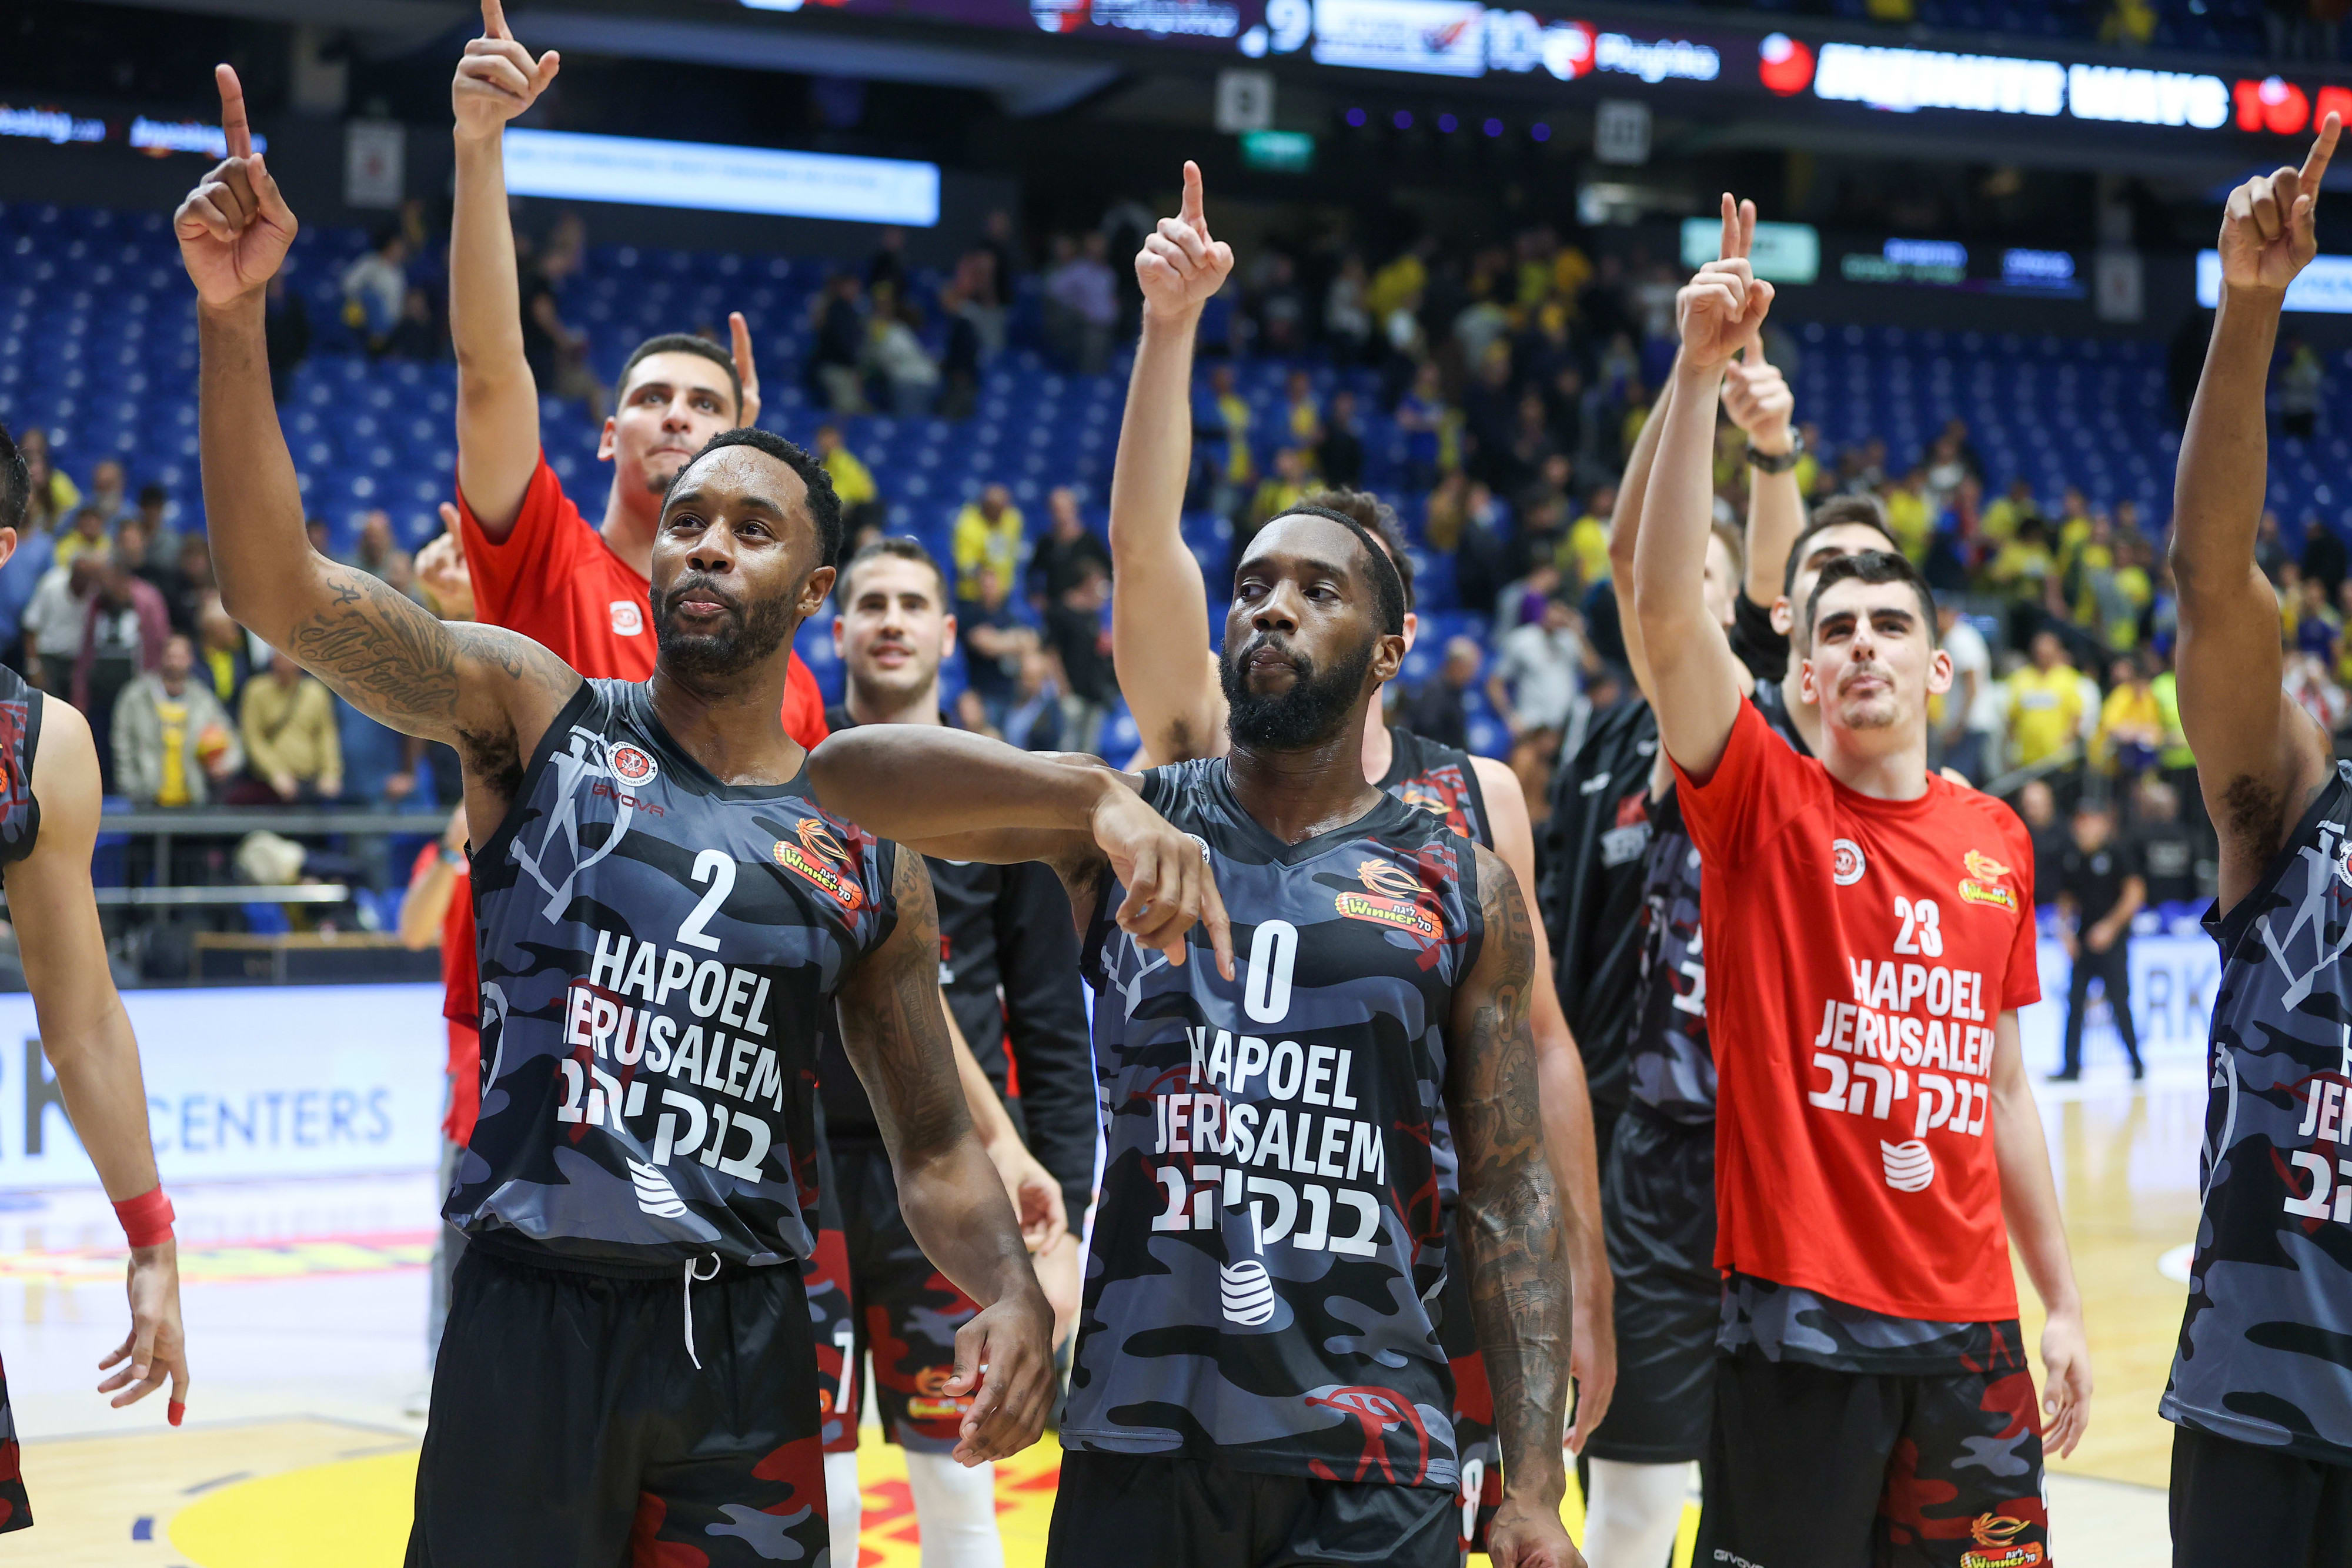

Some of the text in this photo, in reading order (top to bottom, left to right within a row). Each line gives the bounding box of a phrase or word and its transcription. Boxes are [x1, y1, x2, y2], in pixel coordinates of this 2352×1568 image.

[592, 783, 664, 818] GIVOVA
[676, 848, 737, 953] 2
[1894, 895, 1943, 958] 23
[589, 929, 771, 1037] HAPOEL
[1243, 919, 1299, 1024] 0
[1849, 955, 1986, 1022] HAPOEL
[563, 986, 783, 1113] JERUSALEM
[1185, 1025, 1358, 1111] HAPOEL
[1815, 999, 1996, 1079] JERUSALEM
[652, 1088, 771, 1184] בנק
[1155, 1092, 1385, 1186] JERUSALEM
